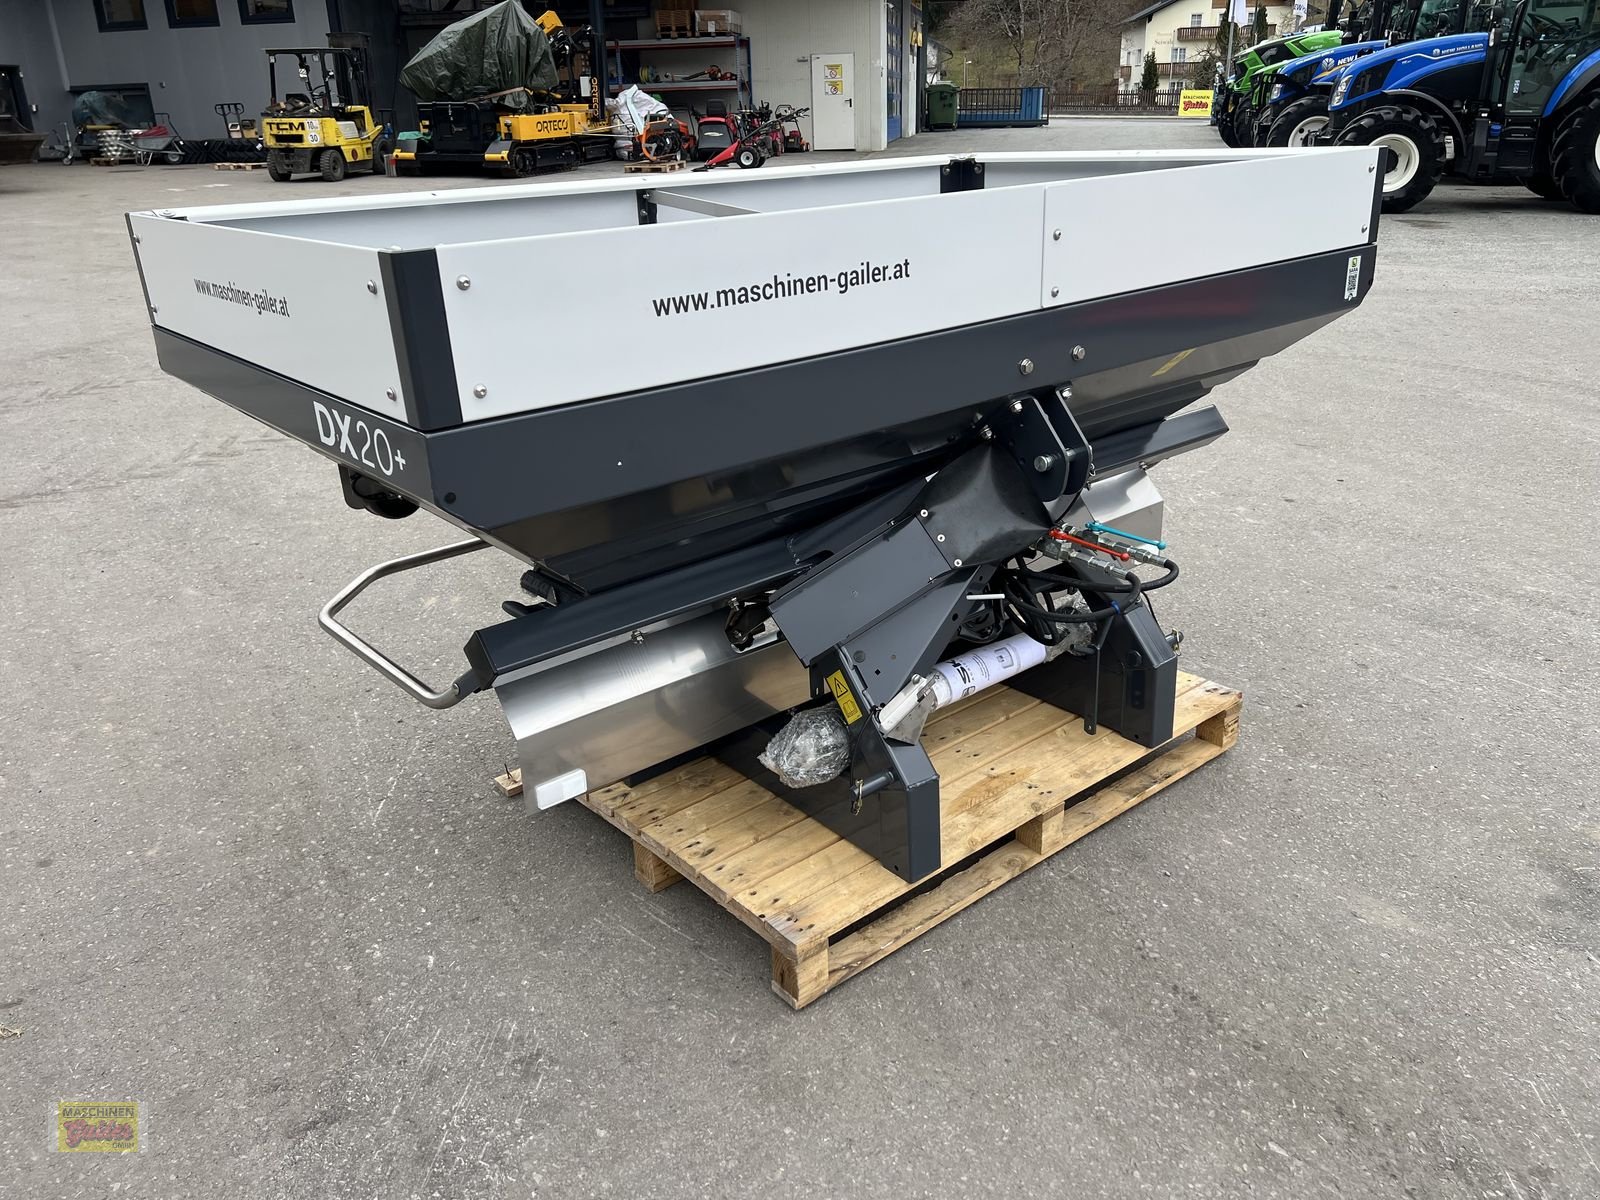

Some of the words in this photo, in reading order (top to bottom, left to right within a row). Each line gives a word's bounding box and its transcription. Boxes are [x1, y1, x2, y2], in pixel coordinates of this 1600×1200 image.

[1337, 55, 1355, 66] NEW
[591, 77, 599, 117] ORTECO
[266, 121, 306, 131] TCM
[310, 134, 319, 142] 30
[536, 120, 569, 133] ORTECO
[193, 278, 290, 317] www.maschinen-gailer.at
[652, 258, 910, 317] www.maschinen-gailer.at
[313, 400, 406, 476] DX20+
